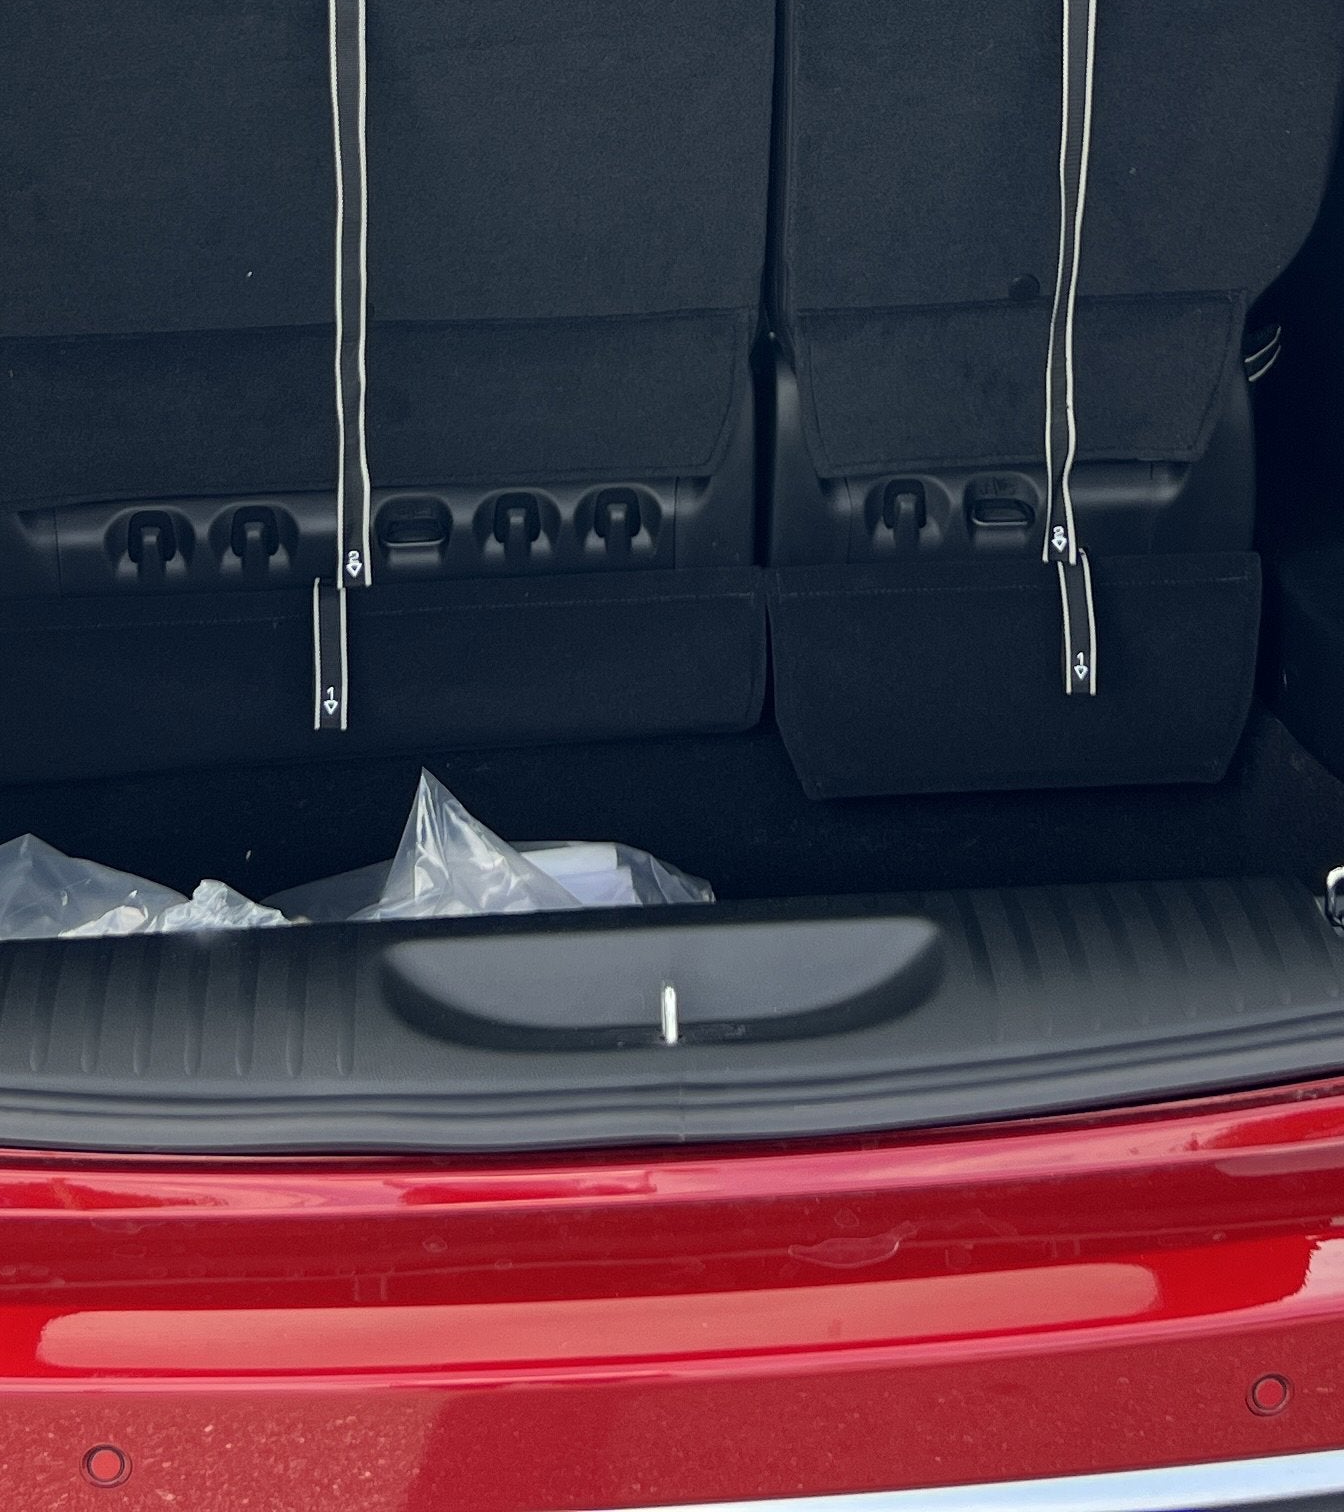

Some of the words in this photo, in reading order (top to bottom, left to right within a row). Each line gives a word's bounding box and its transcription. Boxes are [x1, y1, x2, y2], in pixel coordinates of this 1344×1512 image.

[1053, 525, 1065, 539] 2
[348, 550, 360, 564] 2
[1076, 651, 1084, 666] 1
[326, 686, 334, 700] 1
